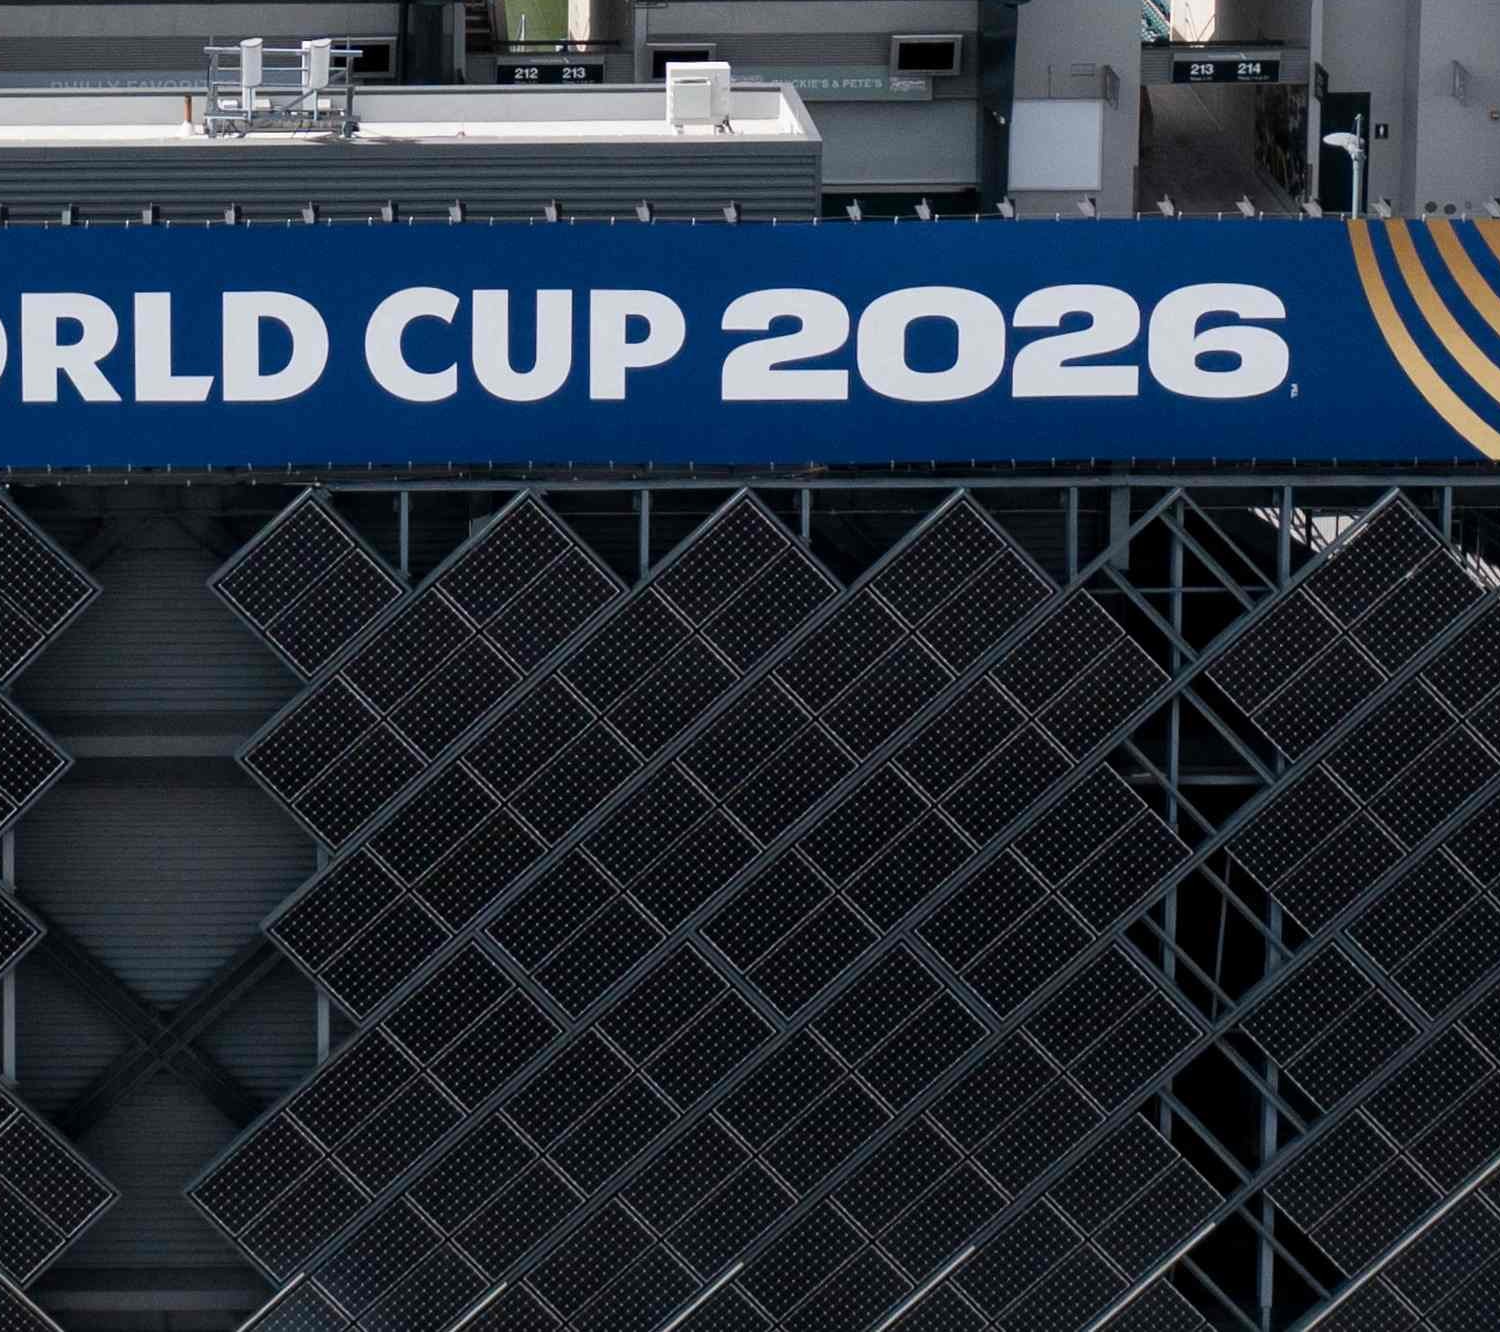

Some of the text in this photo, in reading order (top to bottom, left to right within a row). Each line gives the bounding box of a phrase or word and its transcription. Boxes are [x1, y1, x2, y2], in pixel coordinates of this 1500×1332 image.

[514, 67, 587, 79] 212 213
[1190, 63, 1261, 75] 213 214
[364, 286, 687, 402] CUP
[721, 283, 1290, 402] 2026
